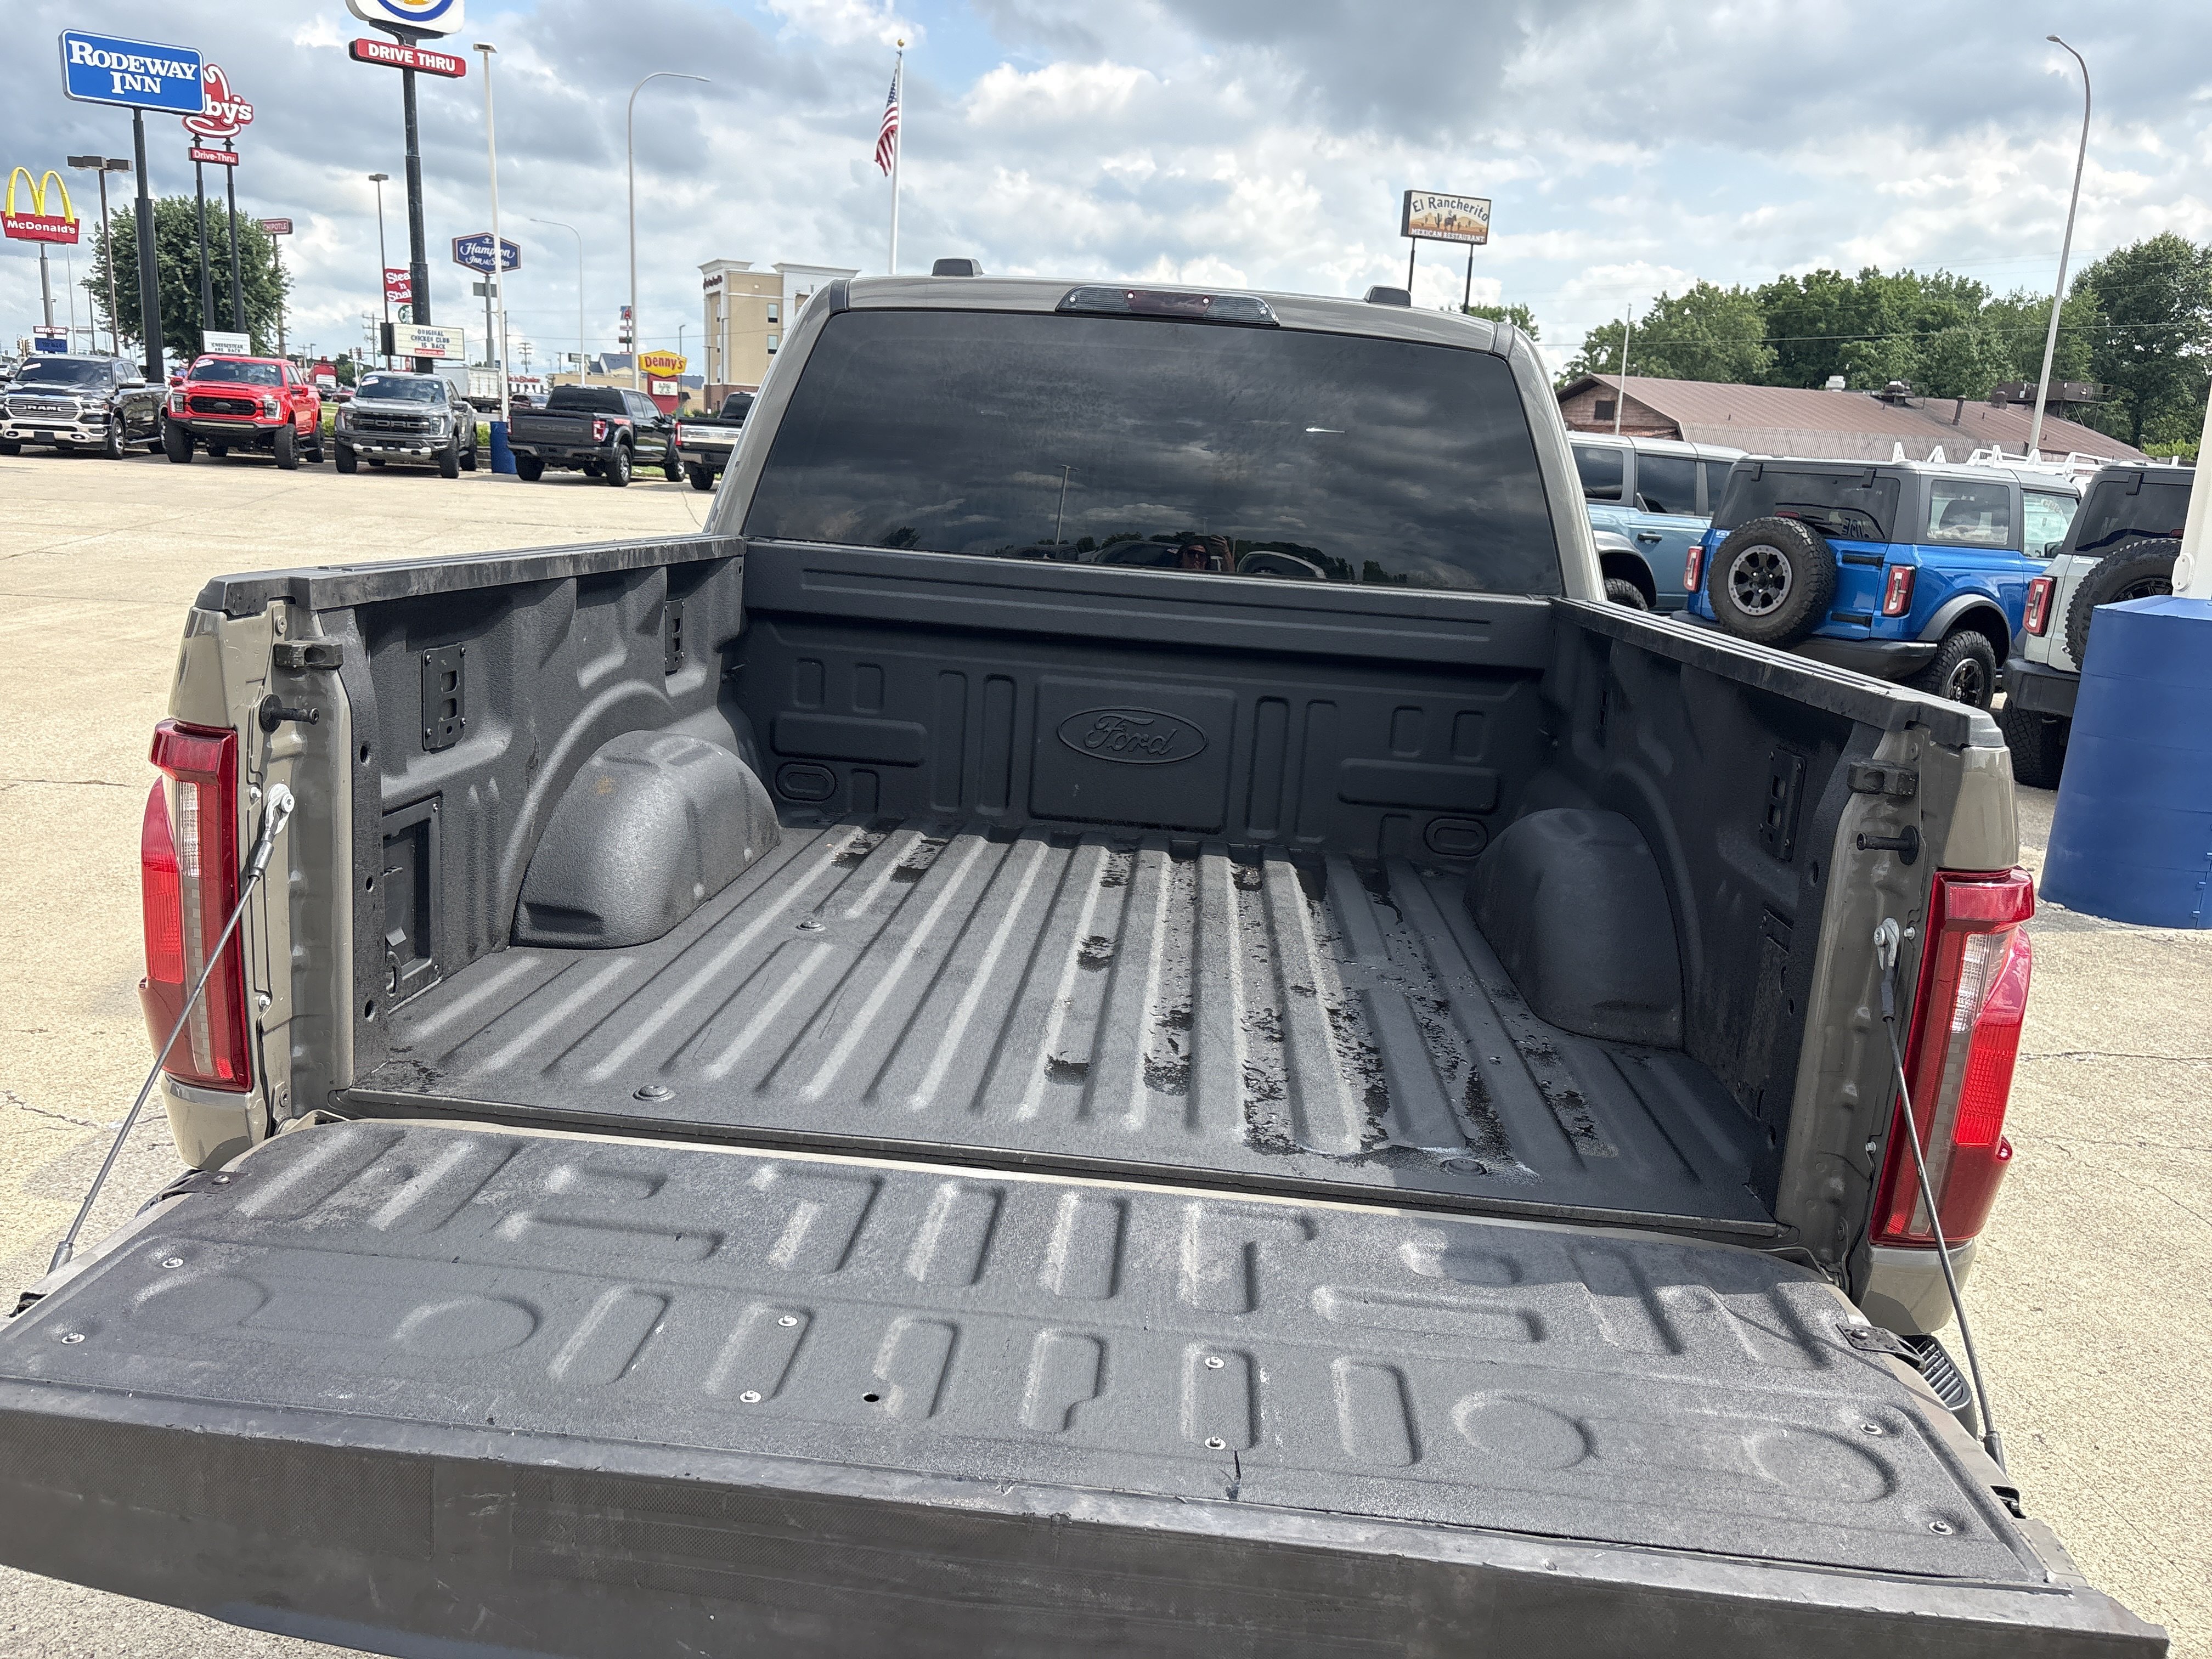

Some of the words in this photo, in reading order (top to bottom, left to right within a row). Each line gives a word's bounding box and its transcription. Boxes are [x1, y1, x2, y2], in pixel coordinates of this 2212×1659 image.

[69, 40, 198, 81] RODEWAY
[368, 43, 414, 64] DRIVE
[417, 52, 455, 72] THRU
[110, 71, 162, 94] INN
[205, 93, 252, 125] by's
[194, 150, 236, 163] Drive-Thru
[1412, 199, 1424, 213] El
[1428, 196, 1488, 222] Rancherito
[7, 220, 76, 234] McDonald's
[1412, 228, 1442, 238] MEXICAN
[1443, 232, 1485, 243] RESTAURANT
[460, 242, 516, 259] Hampon
[386, 272, 411, 284] Stea
[387, 289, 412, 302] Shak
[644, 356, 684, 370] Denny's
[358, 419, 425, 429] FORD
[521, 422, 583, 433] FORD
[1083, 713, 1178, 755] Ford
